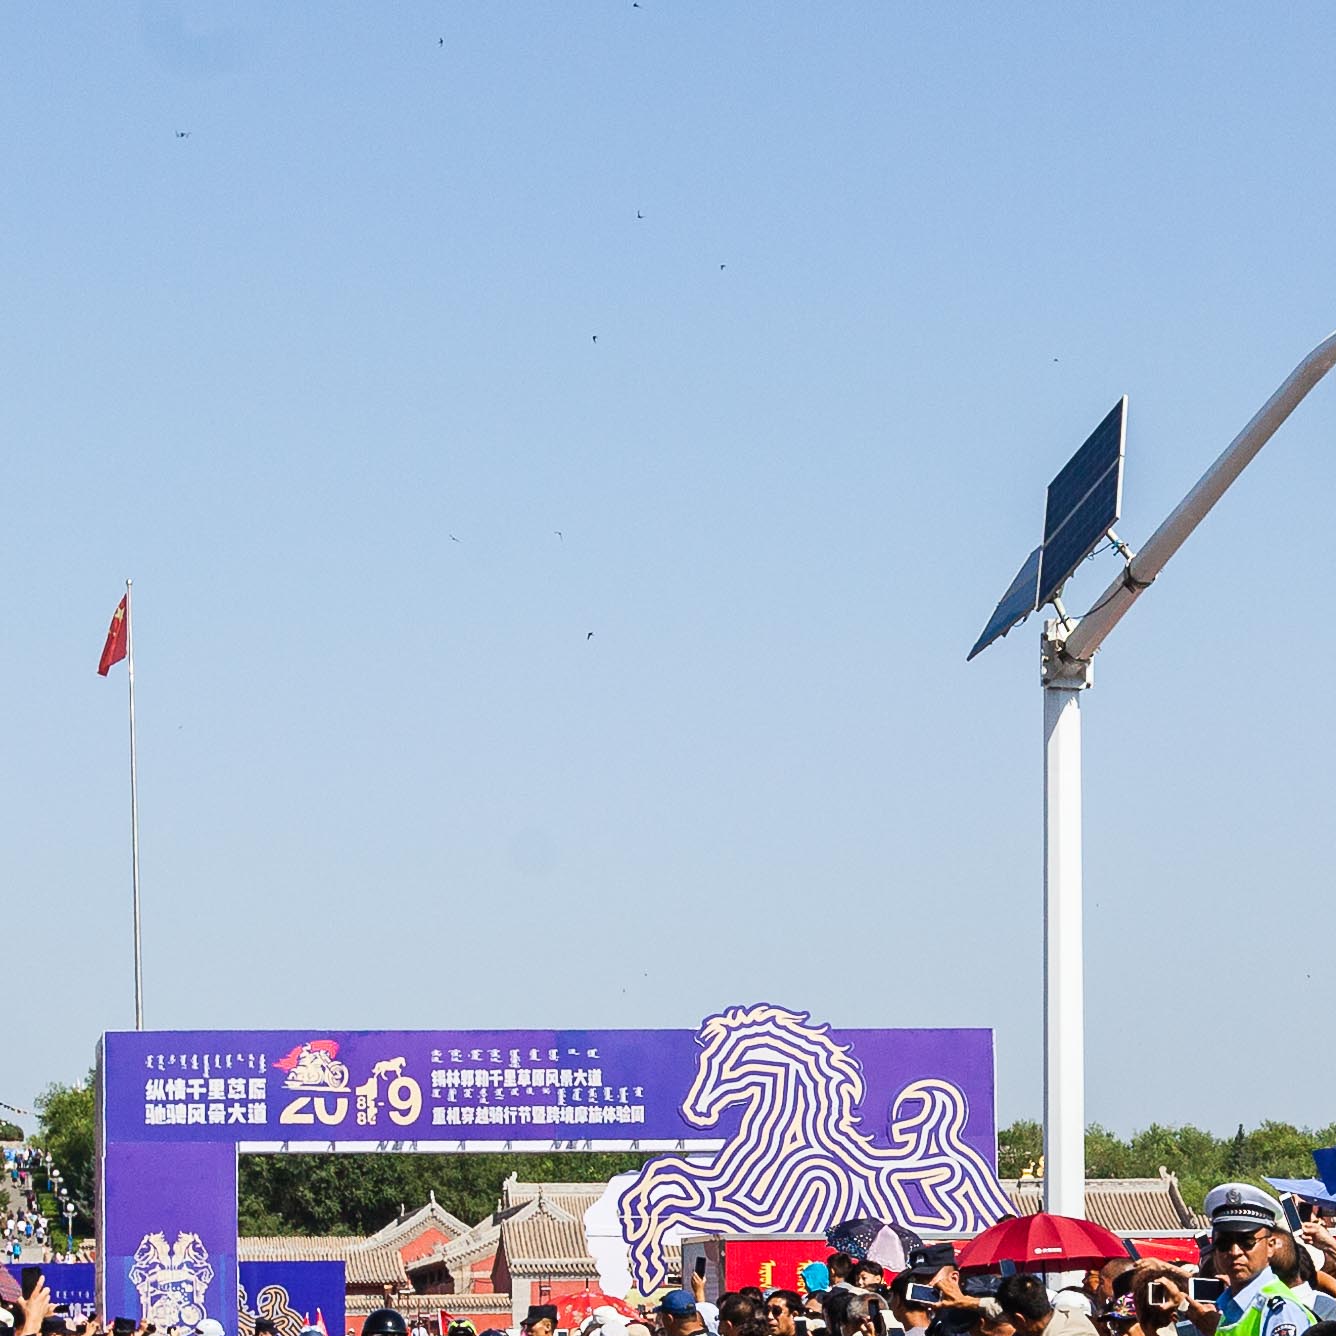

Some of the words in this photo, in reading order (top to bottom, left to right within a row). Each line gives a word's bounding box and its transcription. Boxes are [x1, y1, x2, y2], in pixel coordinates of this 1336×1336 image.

[145, 1078, 267, 1101] 纵情千里草原
[144, 1102, 268, 1125] 驰骋风景大道
